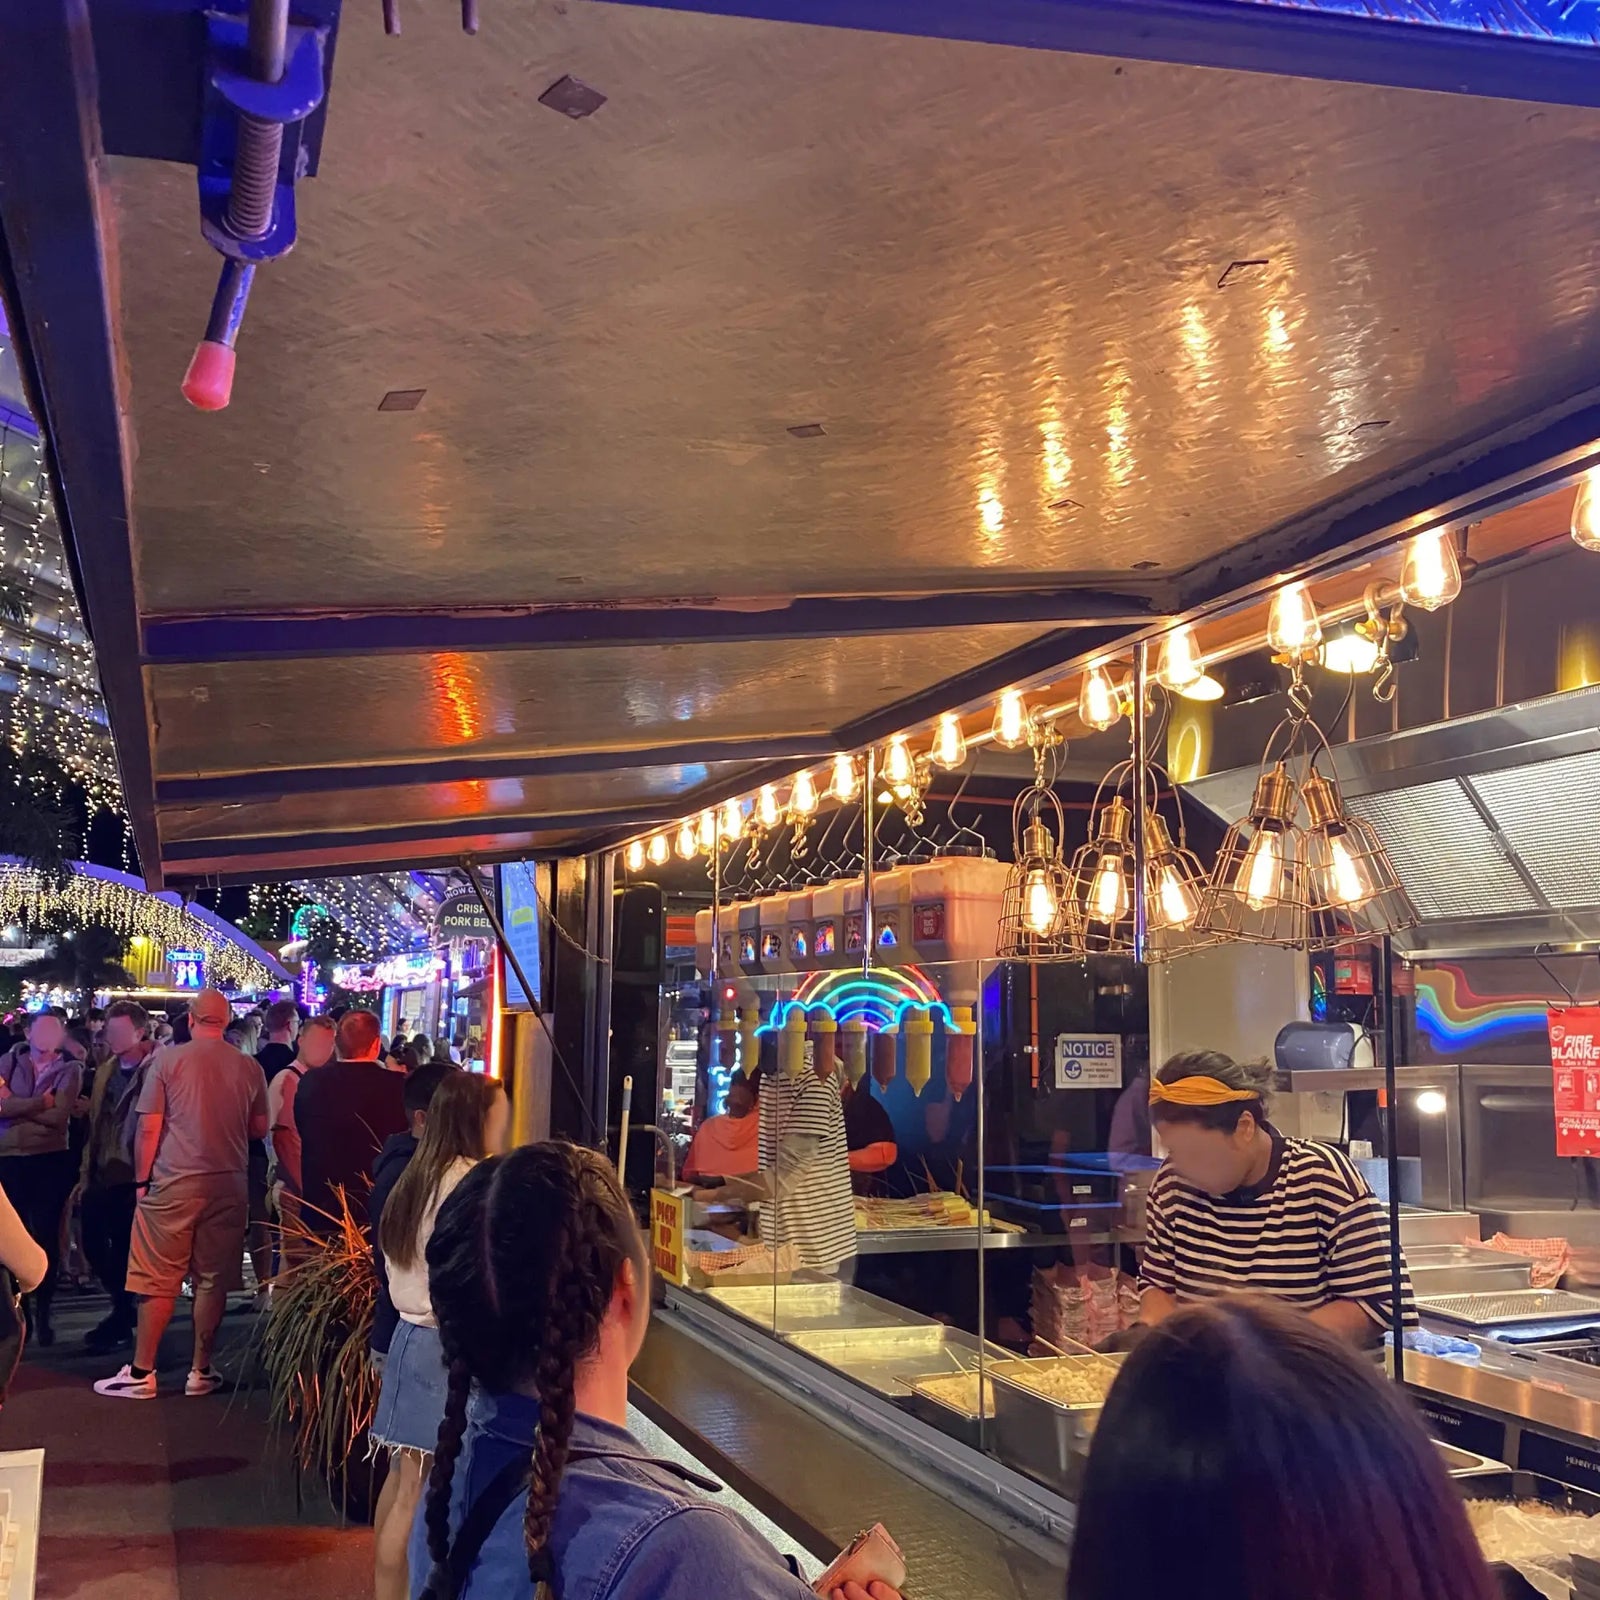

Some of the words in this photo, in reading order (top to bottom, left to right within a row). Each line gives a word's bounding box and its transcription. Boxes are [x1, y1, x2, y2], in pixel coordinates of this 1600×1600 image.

[446, 886, 466, 898] NOW
[456, 903, 485, 914] CRISP
[444, 915, 471, 927] PORK
[473, 917, 493, 928] BEL
[1564, 1035, 1593, 1048] FIRE
[1063, 1042, 1115, 1056] NOTICE
[1552, 1046, 1600, 1060] BLANKE
[660, 1225, 672, 1249] UP
